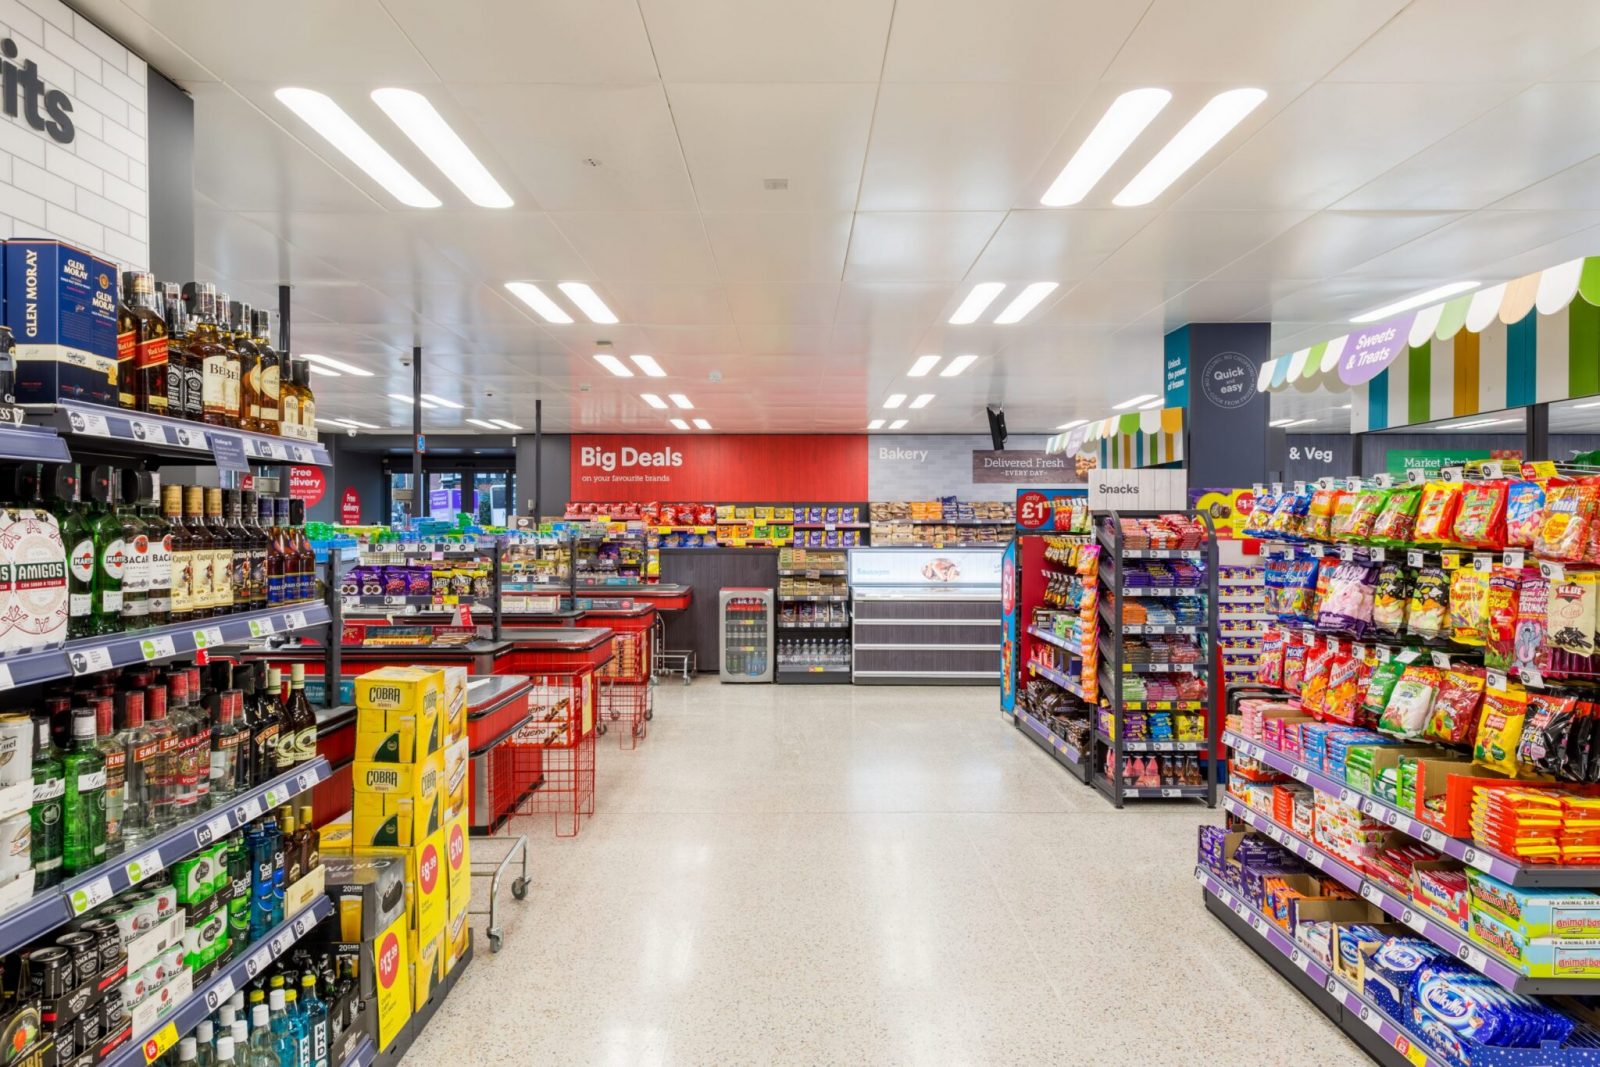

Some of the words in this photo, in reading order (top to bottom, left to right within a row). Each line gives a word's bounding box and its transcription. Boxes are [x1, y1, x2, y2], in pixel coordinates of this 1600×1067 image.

[0, 38, 75, 144] its
[67, 259, 85, 270] GLEN
[26, 249, 37, 300] MORAY
[63, 265, 88, 280] MORAY
[92, 297, 115, 312] MORAY
[96, 291, 112, 303] GLEN
[26, 303, 37, 337] GLEN
[1355, 328, 1397, 350] Sweets
[1168, 357, 1181, 369] Unlock
[1345, 354, 1356, 370] &
[1357, 347, 1391, 367] Treats
[1214, 367, 1245, 380] Quick
[1220, 383, 1243, 394] easy
[581, 446, 616, 472] Big
[621, 446, 683, 467] Deals
[879, 447, 928, 463] Bakery
[984, 457, 1033, 468] Delivered
[1036, 457, 1064, 468] Fresh
[1289, 447, 1300, 460] &
[1304, 447, 1333, 463] Veg
[1404, 457, 1441, 468] Market
[291, 468, 311, 476] Free
[593, 475, 610, 484] your
[612, 474, 643, 482] favourite
[645, 474, 670, 482] brands
[290, 478, 320, 488] elivery
[1099, 483, 1139, 495] Snacks
[1022, 502, 1043, 519] £1
[18, 564, 63, 579] AMIGOS
[369, 687, 400, 705] COBRA
[518, 727, 546, 739] bueno
[366, 771, 397, 788] COBRA
[199, 831, 211, 843] £13
[450, 837, 463, 860] £10
[421, 856, 438, 882] £8.99
[343, 885, 352, 893] 20
[1556, 918, 1586, 928] Animal
[379, 943, 399, 976] £13.99
[1559, 957, 1588, 968] Animal
[316, 1024, 325, 1058] WKD
